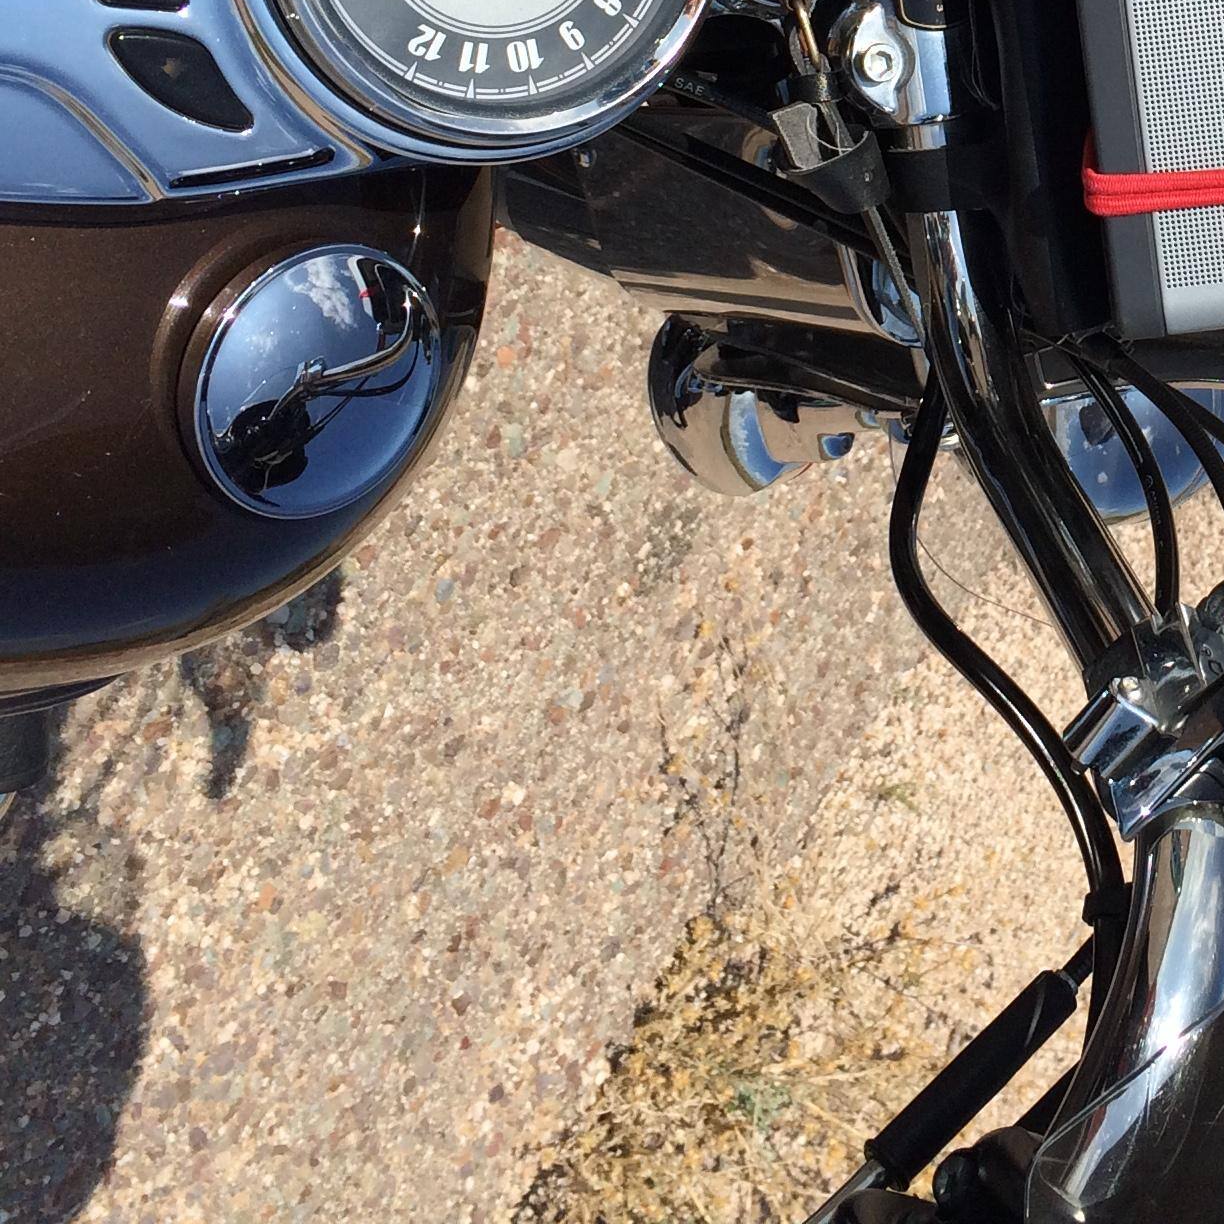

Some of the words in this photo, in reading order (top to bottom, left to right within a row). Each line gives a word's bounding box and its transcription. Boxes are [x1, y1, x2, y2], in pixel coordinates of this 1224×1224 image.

[407, 24, 447, 62] 12
[559, 20, 586, 51] 9
[458, 41, 491, 74] 11
[506, 38, 545, 73] 10
[674, 77, 706, 97] SAE
